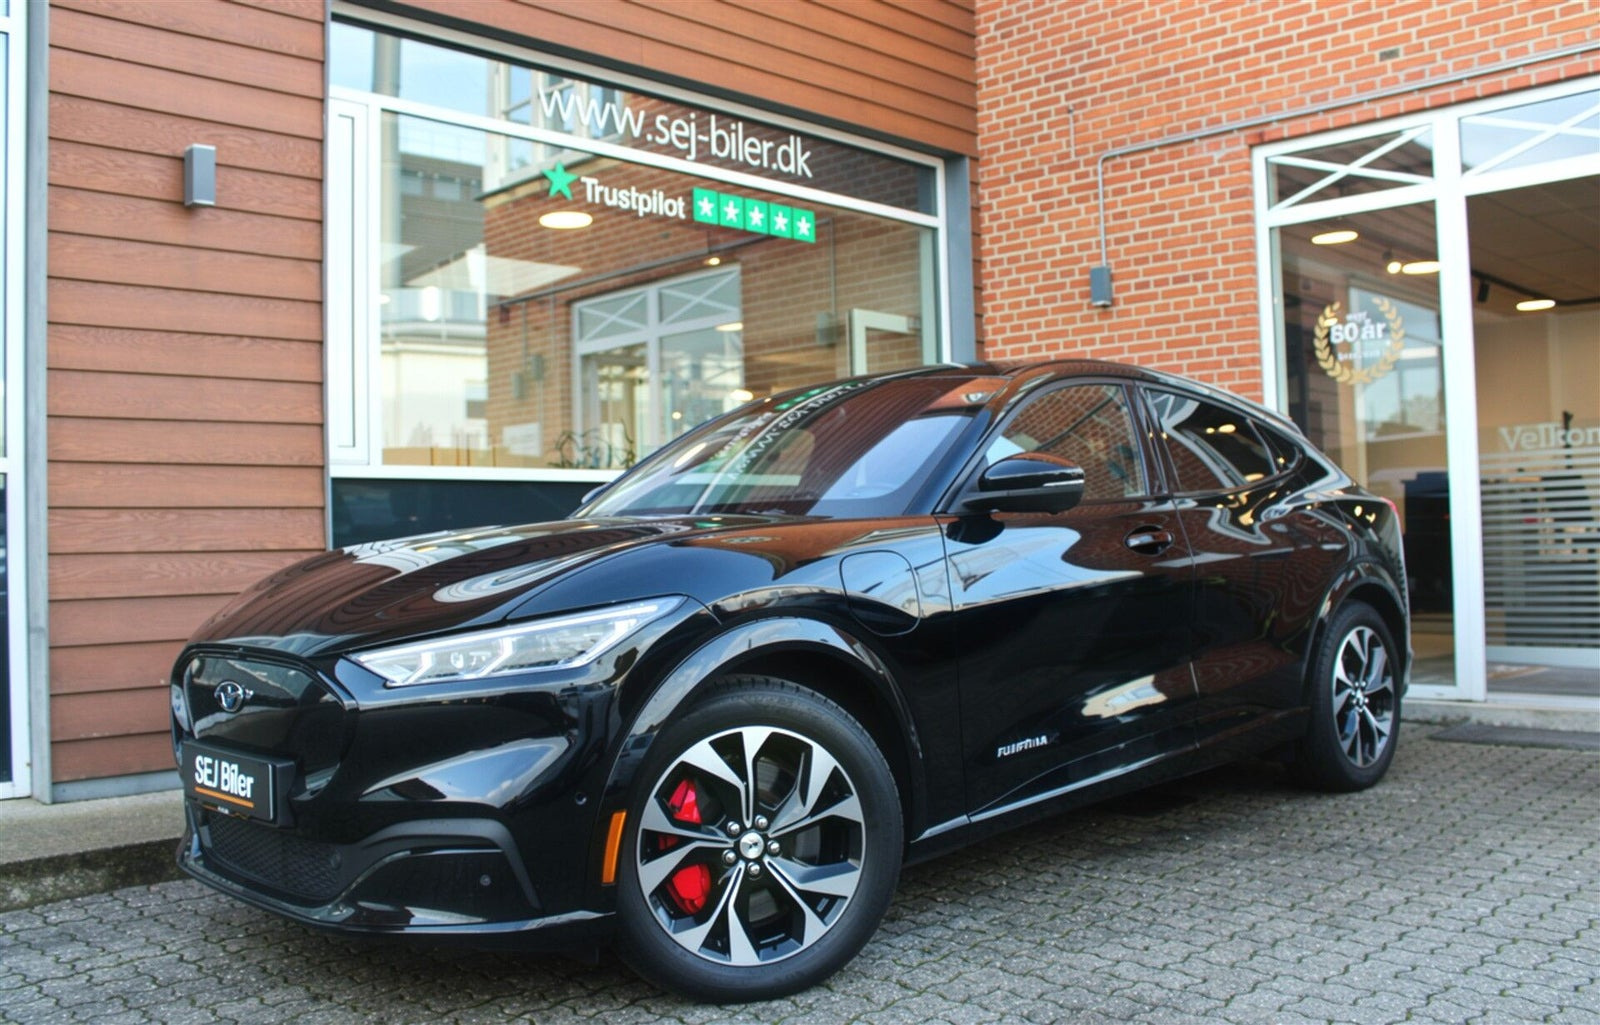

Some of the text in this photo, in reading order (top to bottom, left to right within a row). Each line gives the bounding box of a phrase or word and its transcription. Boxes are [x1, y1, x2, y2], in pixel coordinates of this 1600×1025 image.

[538, 87, 813, 178] www.sej-biler.dk
[580, 176, 686, 219] Trustpilot
[194, 755, 254, 798] SEJ Biler
